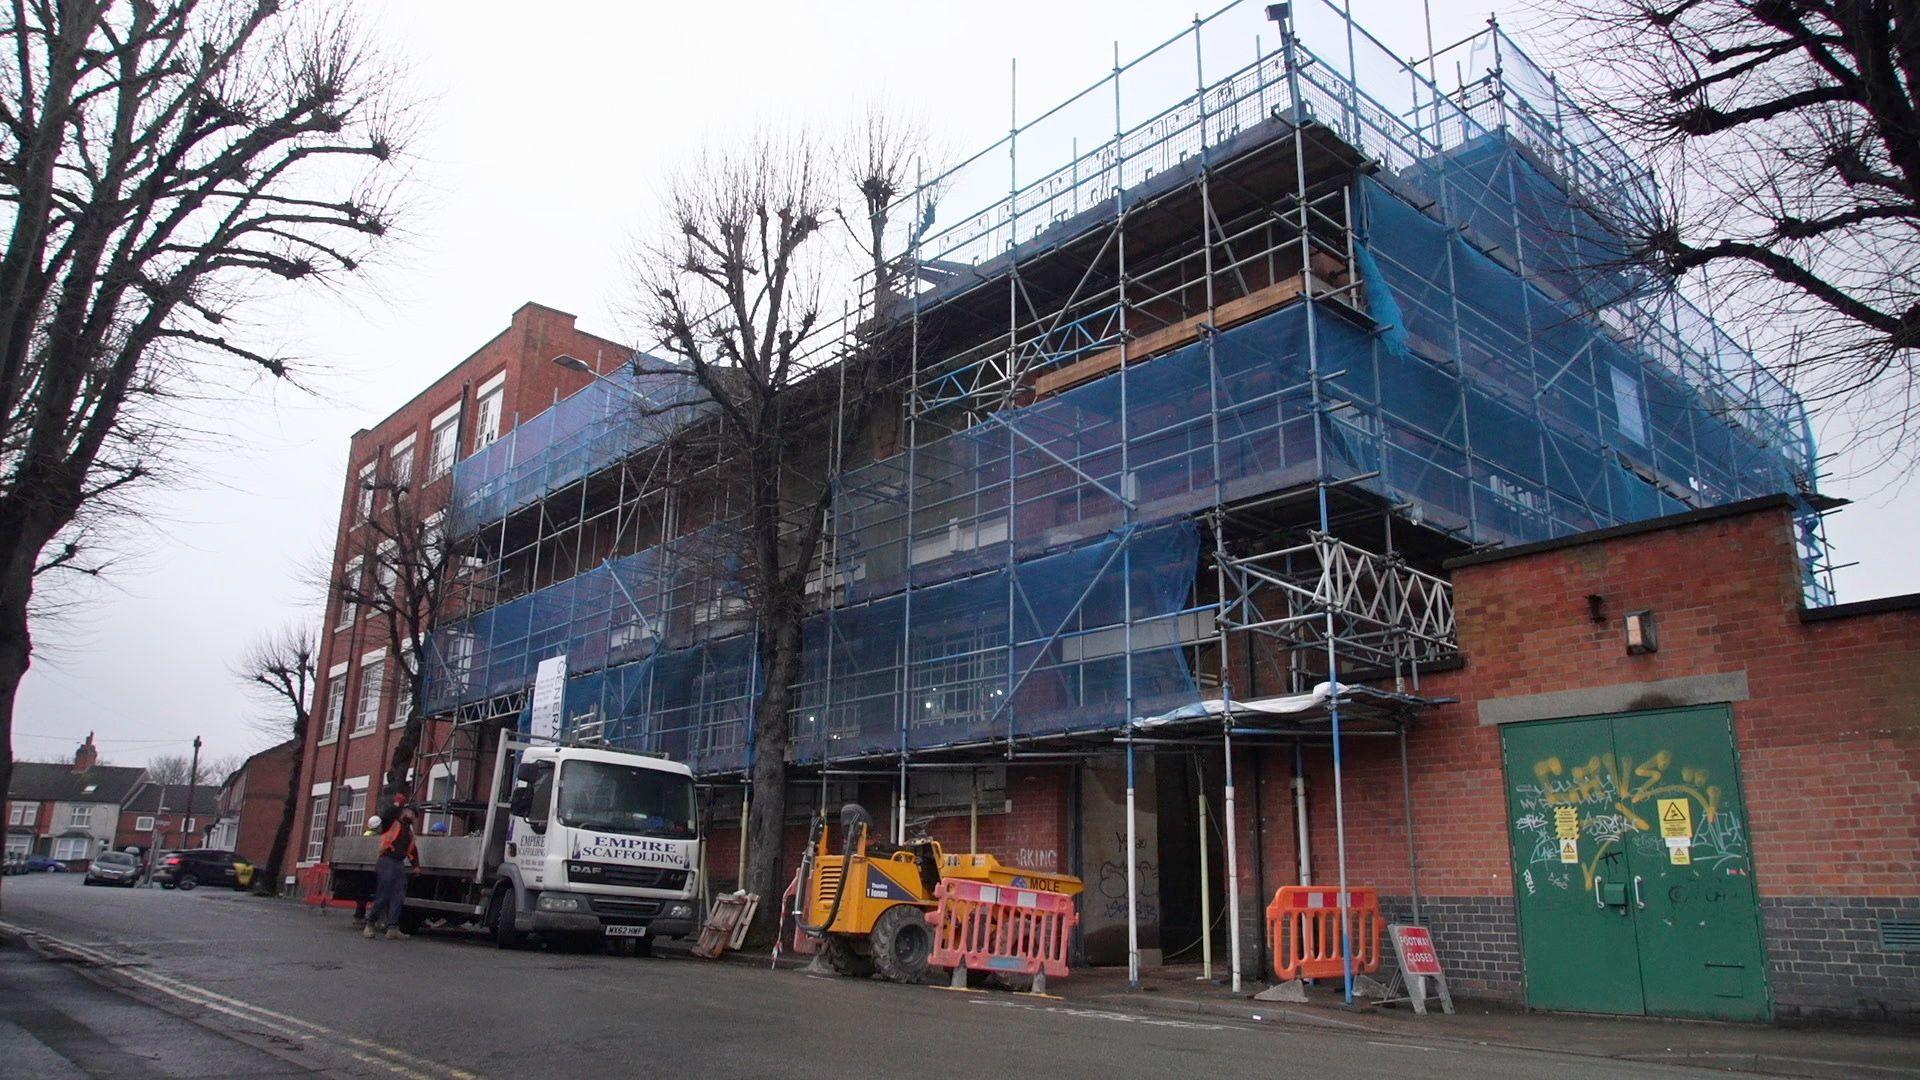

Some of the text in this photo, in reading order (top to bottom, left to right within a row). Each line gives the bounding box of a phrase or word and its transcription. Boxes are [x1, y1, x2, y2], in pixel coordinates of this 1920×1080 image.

[520, 835, 546, 847] EMPIRE
[595, 836, 677, 853] EMPIRE
[582, 846, 684, 865] SCAFFOLDING
[570, 865, 602, 874] DAF
[1030, 878, 1060, 892] MOLE
[1399, 935, 1431, 947] FOOTWAY
[1407, 952, 1434, 963] CLOSED
